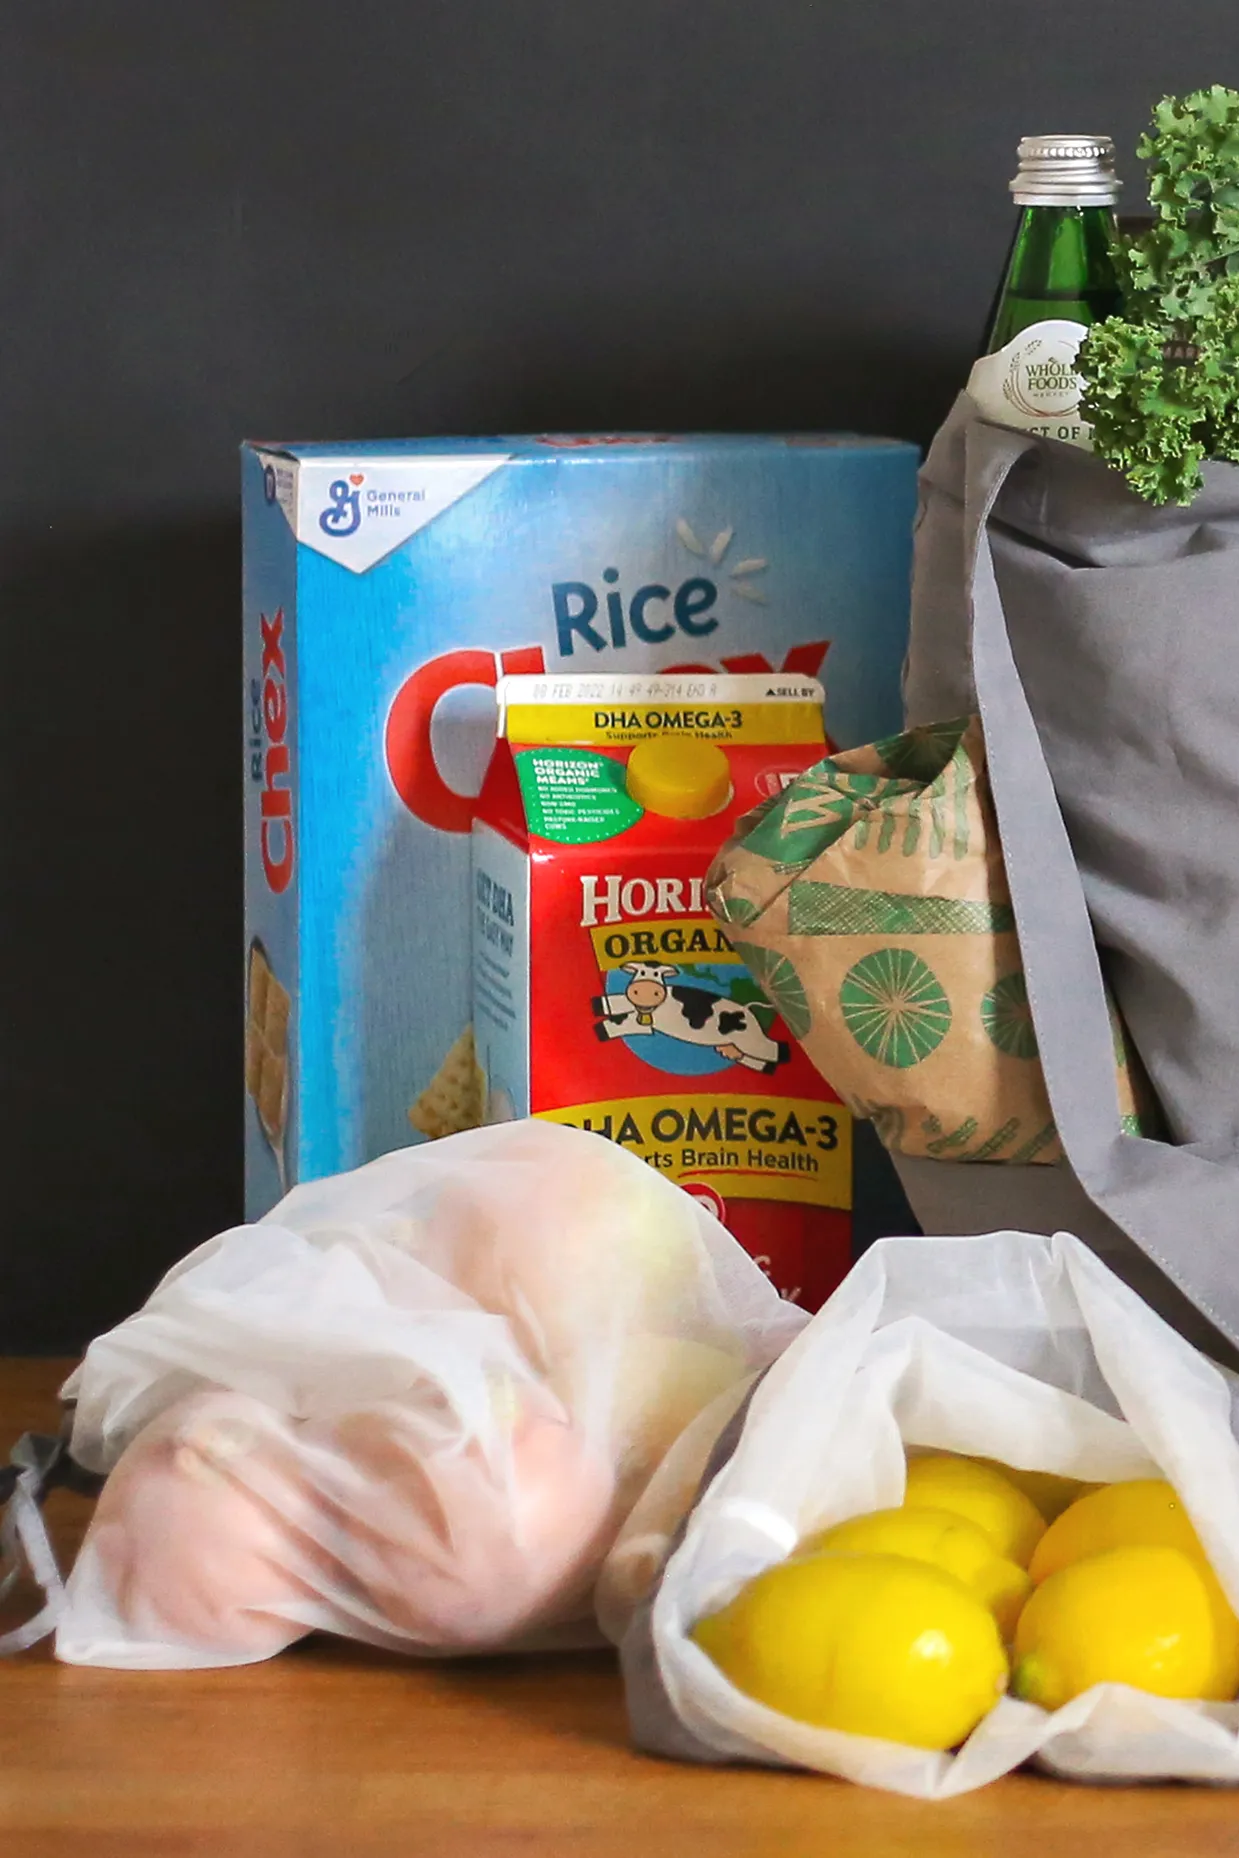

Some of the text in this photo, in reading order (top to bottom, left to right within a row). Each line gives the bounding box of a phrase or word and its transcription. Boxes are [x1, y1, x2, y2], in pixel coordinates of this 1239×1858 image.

[1028, 376, 1077, 391] FOODS
[1057, 426, 1081, 440] OF
[366, 488, 426, 502] General
[367, 505, 401, 517] Mills
[551, 568, 719, 657] Rice
[801, 687, 815, 697] BY
[595, 710, 743, 729] DHA OMEGA-3
[261, 606, 295, 895] Chex
[580, 875, 711, 927] HORI
[604, 927, 737, 959] ORGAN
[561, 1107, 838, 1151] HA OMEGA-3
[681, 1147, 739, 1168] Brain
[747, 1148, 819, 1173] Health
